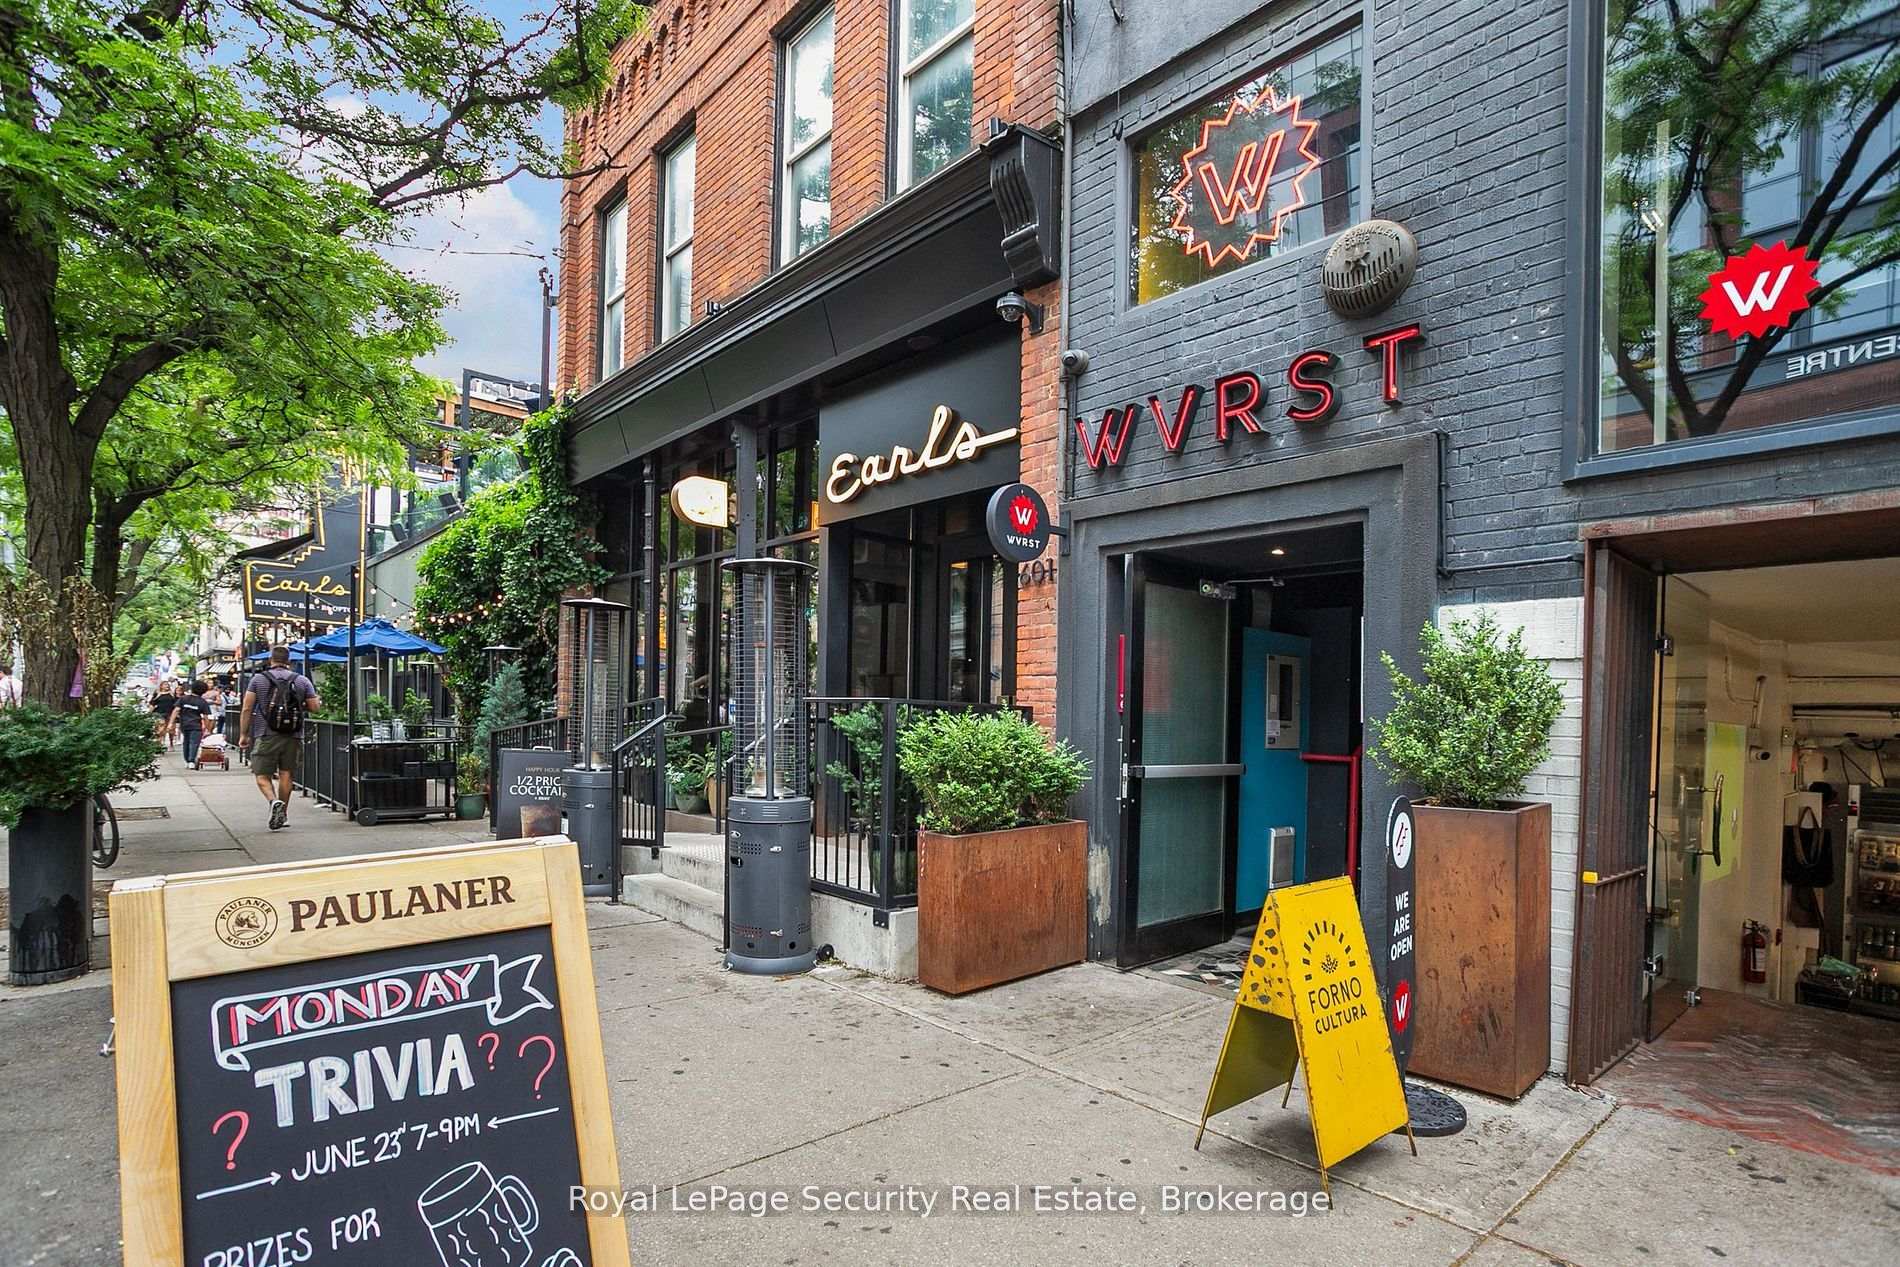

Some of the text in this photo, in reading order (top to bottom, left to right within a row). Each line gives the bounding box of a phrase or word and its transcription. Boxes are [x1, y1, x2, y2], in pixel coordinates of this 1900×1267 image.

[1200, 130, 1285, 224] W
[1722, 264, 1794, 317] W
[1074, 322, 1426, 471] WVRST
[825, 404, 1019, 504] Earls
[1015, 506, 1033, 526] W
[1006, 535, 1041, 549] WVRST
[255, 573, 351, 596] Earls
[1020, 557, 1054, 586] 601
[255, 598, 293, 608] KITCHEN
[298, 602, 316, 610] BR
[509, 785, 562, 796] COCKTAI
[517, 775, 562, 787] 1/2 PRIC
[220, 899, 272, 920] PAULANER
[289, 875, 515, 933] PAULANER
[1395, 890, 1409, 912] WE
[1393, 913, 1410, 937] ARE
[1390, 935, 1413, 961] OPEN
[229, 963, 481, 1046] MONDAY
[1308, 977, 1362, 1015] FORNO
[1395, 992, 1408, 1022] W
[1315, 1003, 1368, 1035] CULTURA
[254, 1033, 476, 1128] TRIVIA
[291, 1136, 370, 1182] JUNE
[409, 1112, 481, 1151] 7-9PM
[330, 1207, 381, 1251] FOR
